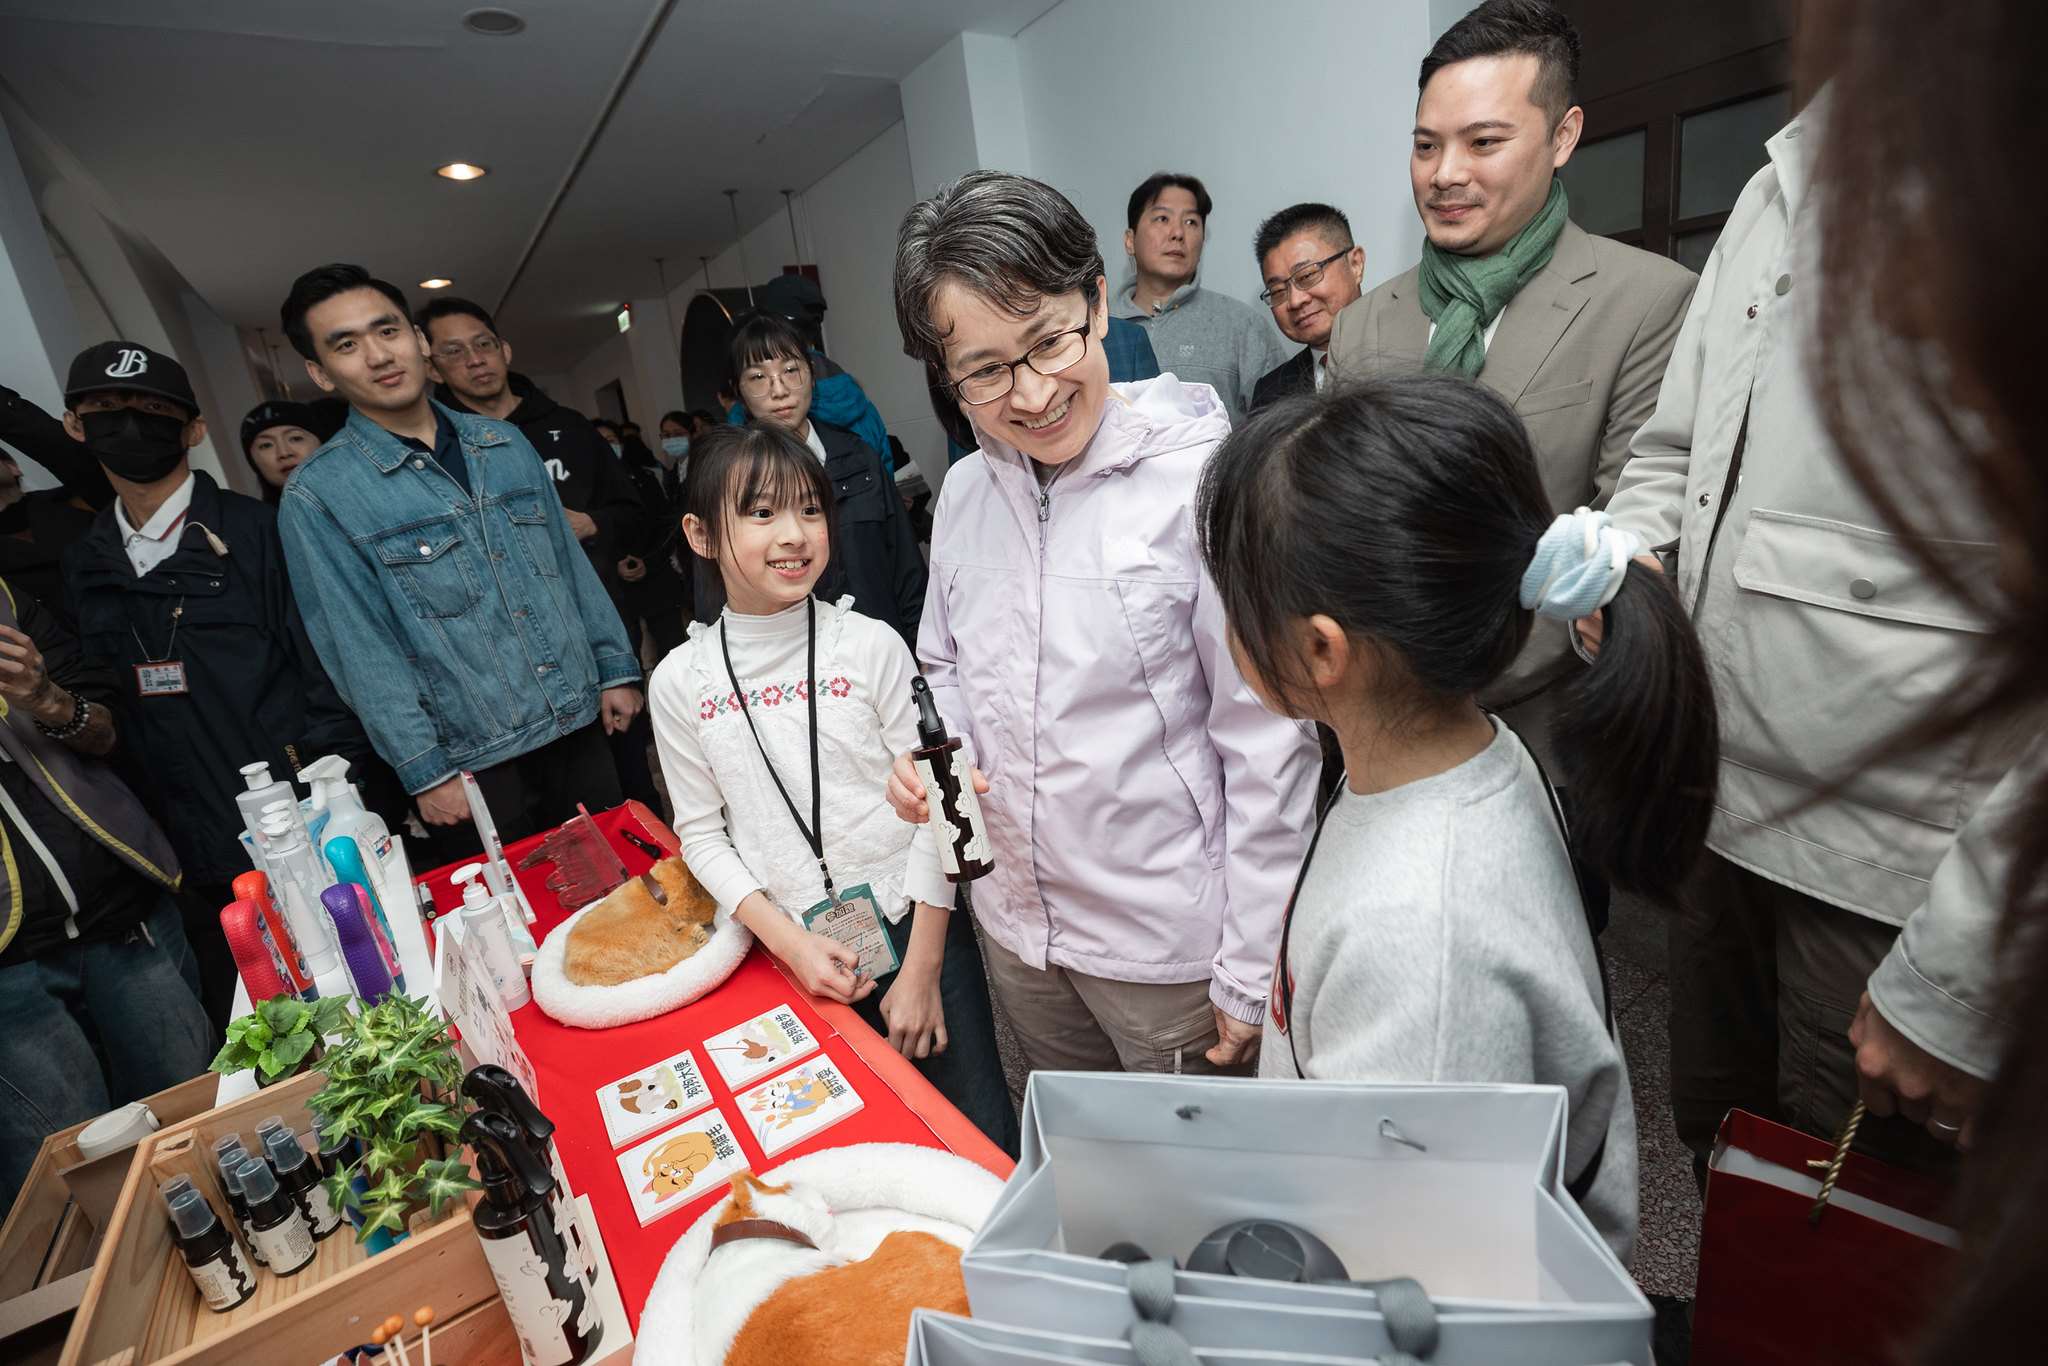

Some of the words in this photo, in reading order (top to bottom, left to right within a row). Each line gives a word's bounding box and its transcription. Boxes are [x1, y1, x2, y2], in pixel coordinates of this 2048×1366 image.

[775, 1013, 807, 1045] 狗狗散步
[674, 1059, 704, 1098] 狗狗大便
